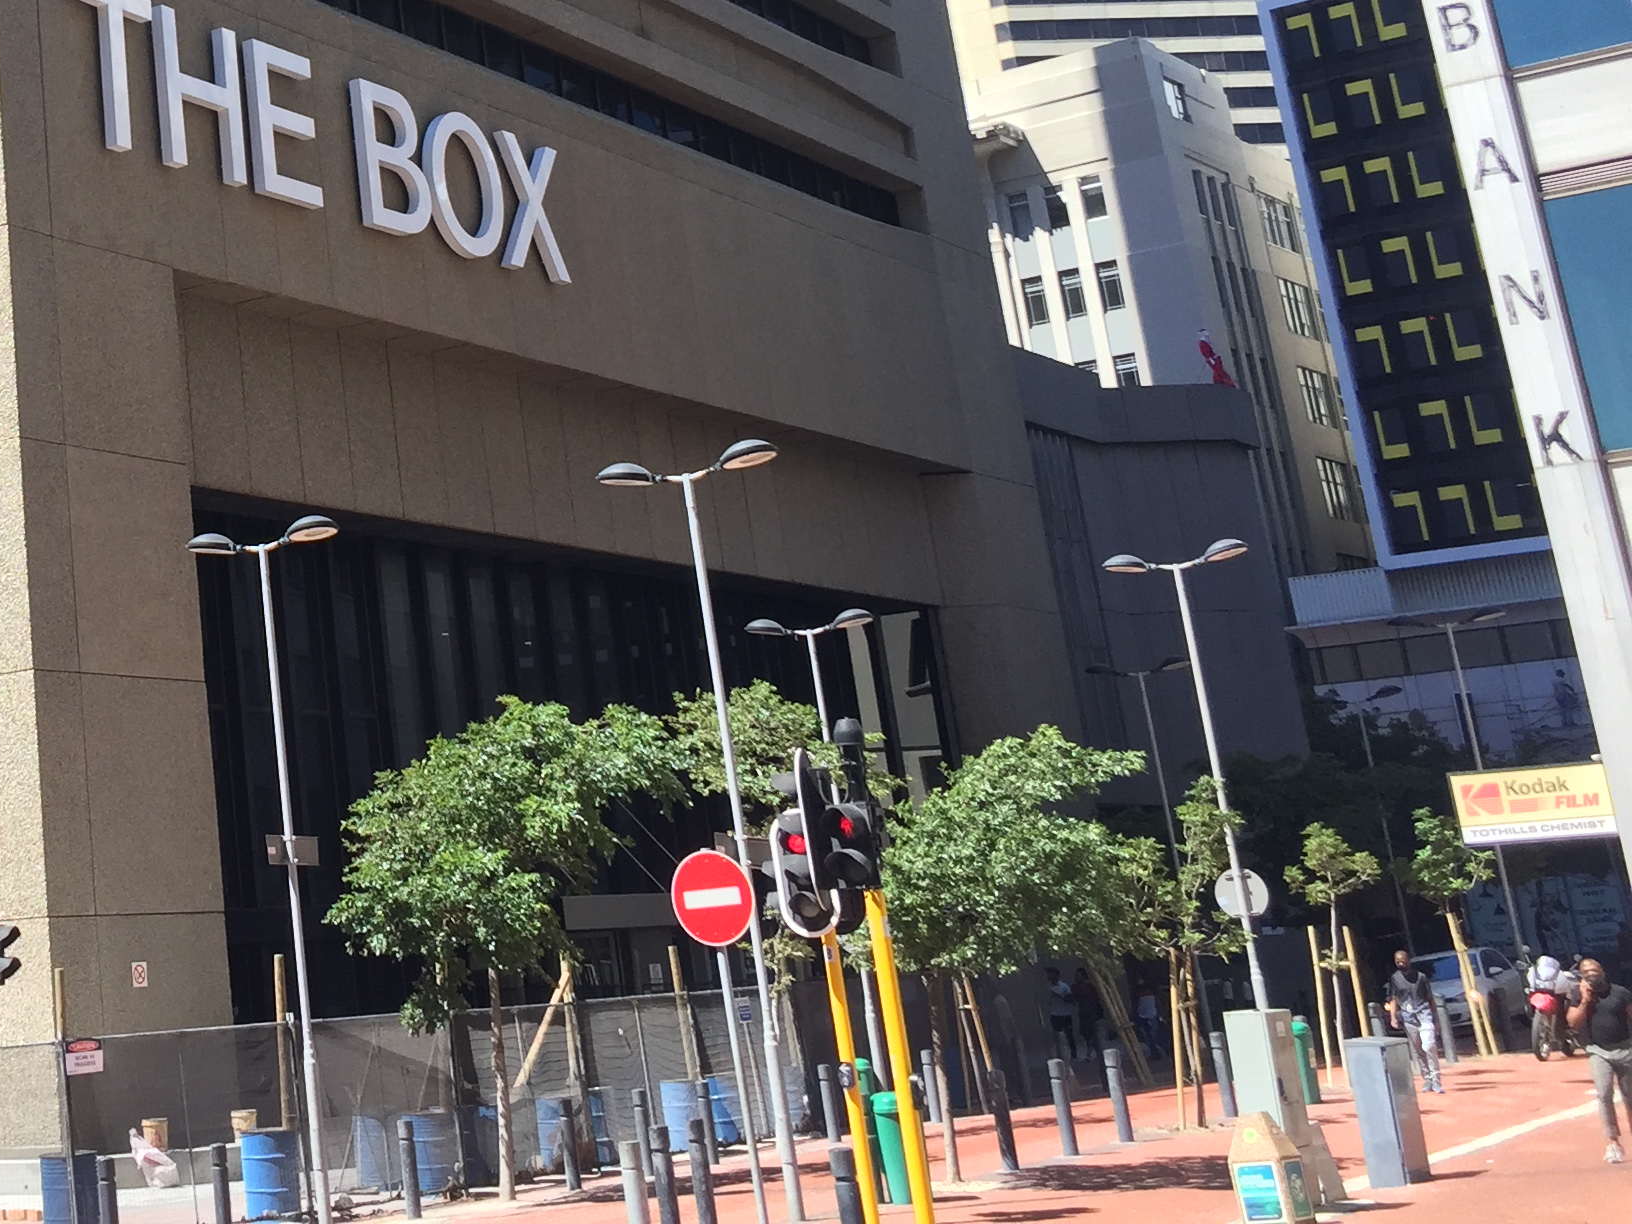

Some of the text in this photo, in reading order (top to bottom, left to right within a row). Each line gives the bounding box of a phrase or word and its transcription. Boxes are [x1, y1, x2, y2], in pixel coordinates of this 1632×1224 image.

[349, 77, 572, 286] BOX
[1436, 1, 1585, 468] BANK
[1503, 776, 1570, 797] Kodak
[1555, 792, 1600, 810] FILM
[1470, 820, 1606, 838] TOTHILLS CHEMIST
